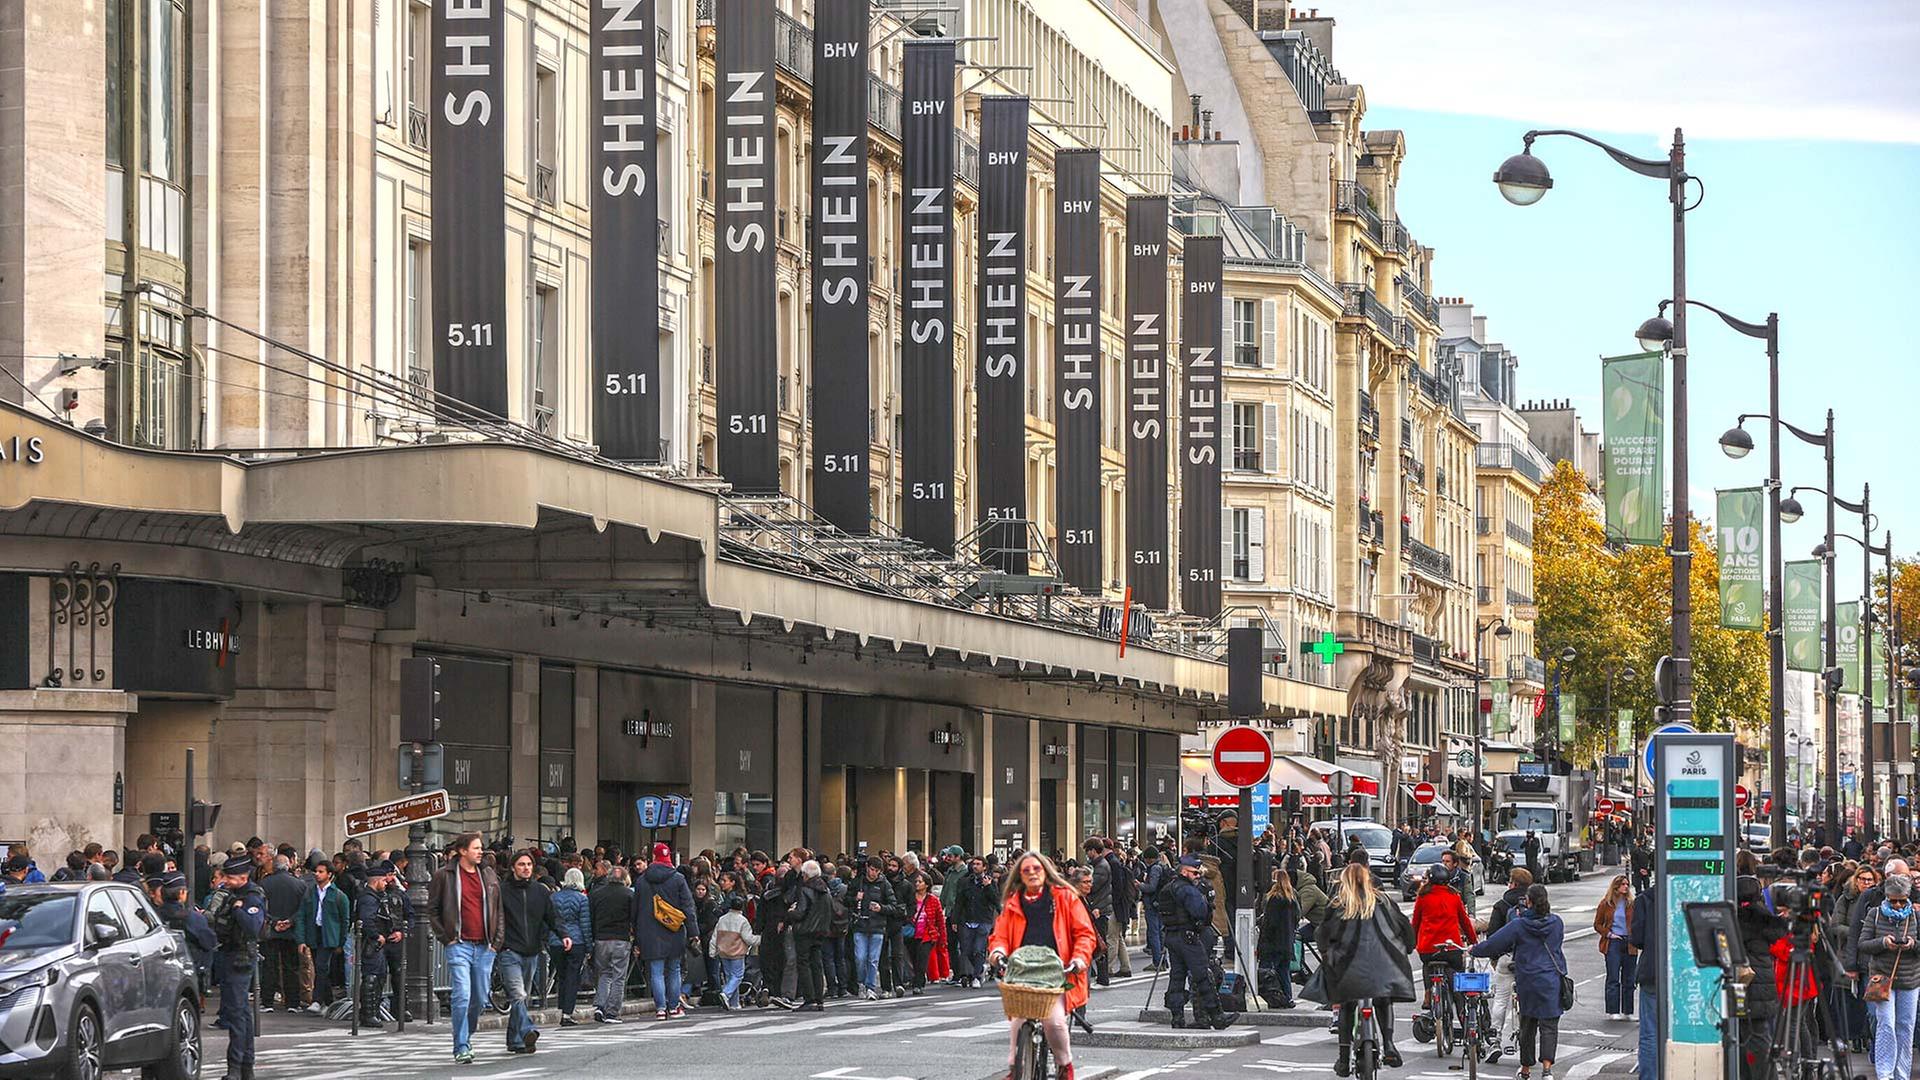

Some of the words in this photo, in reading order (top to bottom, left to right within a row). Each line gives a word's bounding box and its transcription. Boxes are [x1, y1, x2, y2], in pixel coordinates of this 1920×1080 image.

[824, 42, 858, 58] BHV
[601, 0, 646, 196] SHEIN
[912, 100, 945, 115] BHV
[726, 71, 765, 253] SHEIN
[988, 151, 1019, 165] BHV
[1063, 200, 1092, 213] BHV
[822, 136, 858, 305] SHEIN
[1133, 244, 1160, 256] BHV
[911, 187, 945, 344] SHEIN
[1190, 281, 1216, 293] BHV
[986, 232, 1017, 378] SHEIN
[448, 323, 493, 347] 5.11
[1063, 275, 1093, 410] SHEIN
[605, 373, 646, 395] 5.11
[1132, 313, 1160, 440] SHEIN
[1189, 347, 1215, 465] SHEIN
[729, 414, 766, 434] 5.11
[1610, 436, 1656, 445] L'ACCORD
[1612, 447, 1626, 455] DE
[1629, 447, 1656, 455] PARIS
[824, 454, 858, 473] 5.11
[1614, 457, 1642, 465] POUR
[1644, 457, 1656, 465] LE
[1616, 467, 1652, 475] CLIMAT
[912, 482, 944, 500] 5.11
[1065, 529, 1094, 544] 5.11
[1721, 526, 1760, 553] 10
[1134, 550, 1160, 563] 5.11
[1722, 554, 1760, 567] ANS
[1189, 568, 1214, 582] 5.11
[188, 629, 202, 648] LE
[455, 760, 470, 784] BHV
[549, 763, 564, 787] BHV
[1704, 861, 1725, 874] 41
[1688, 979, 1701, 1019] PARIS
